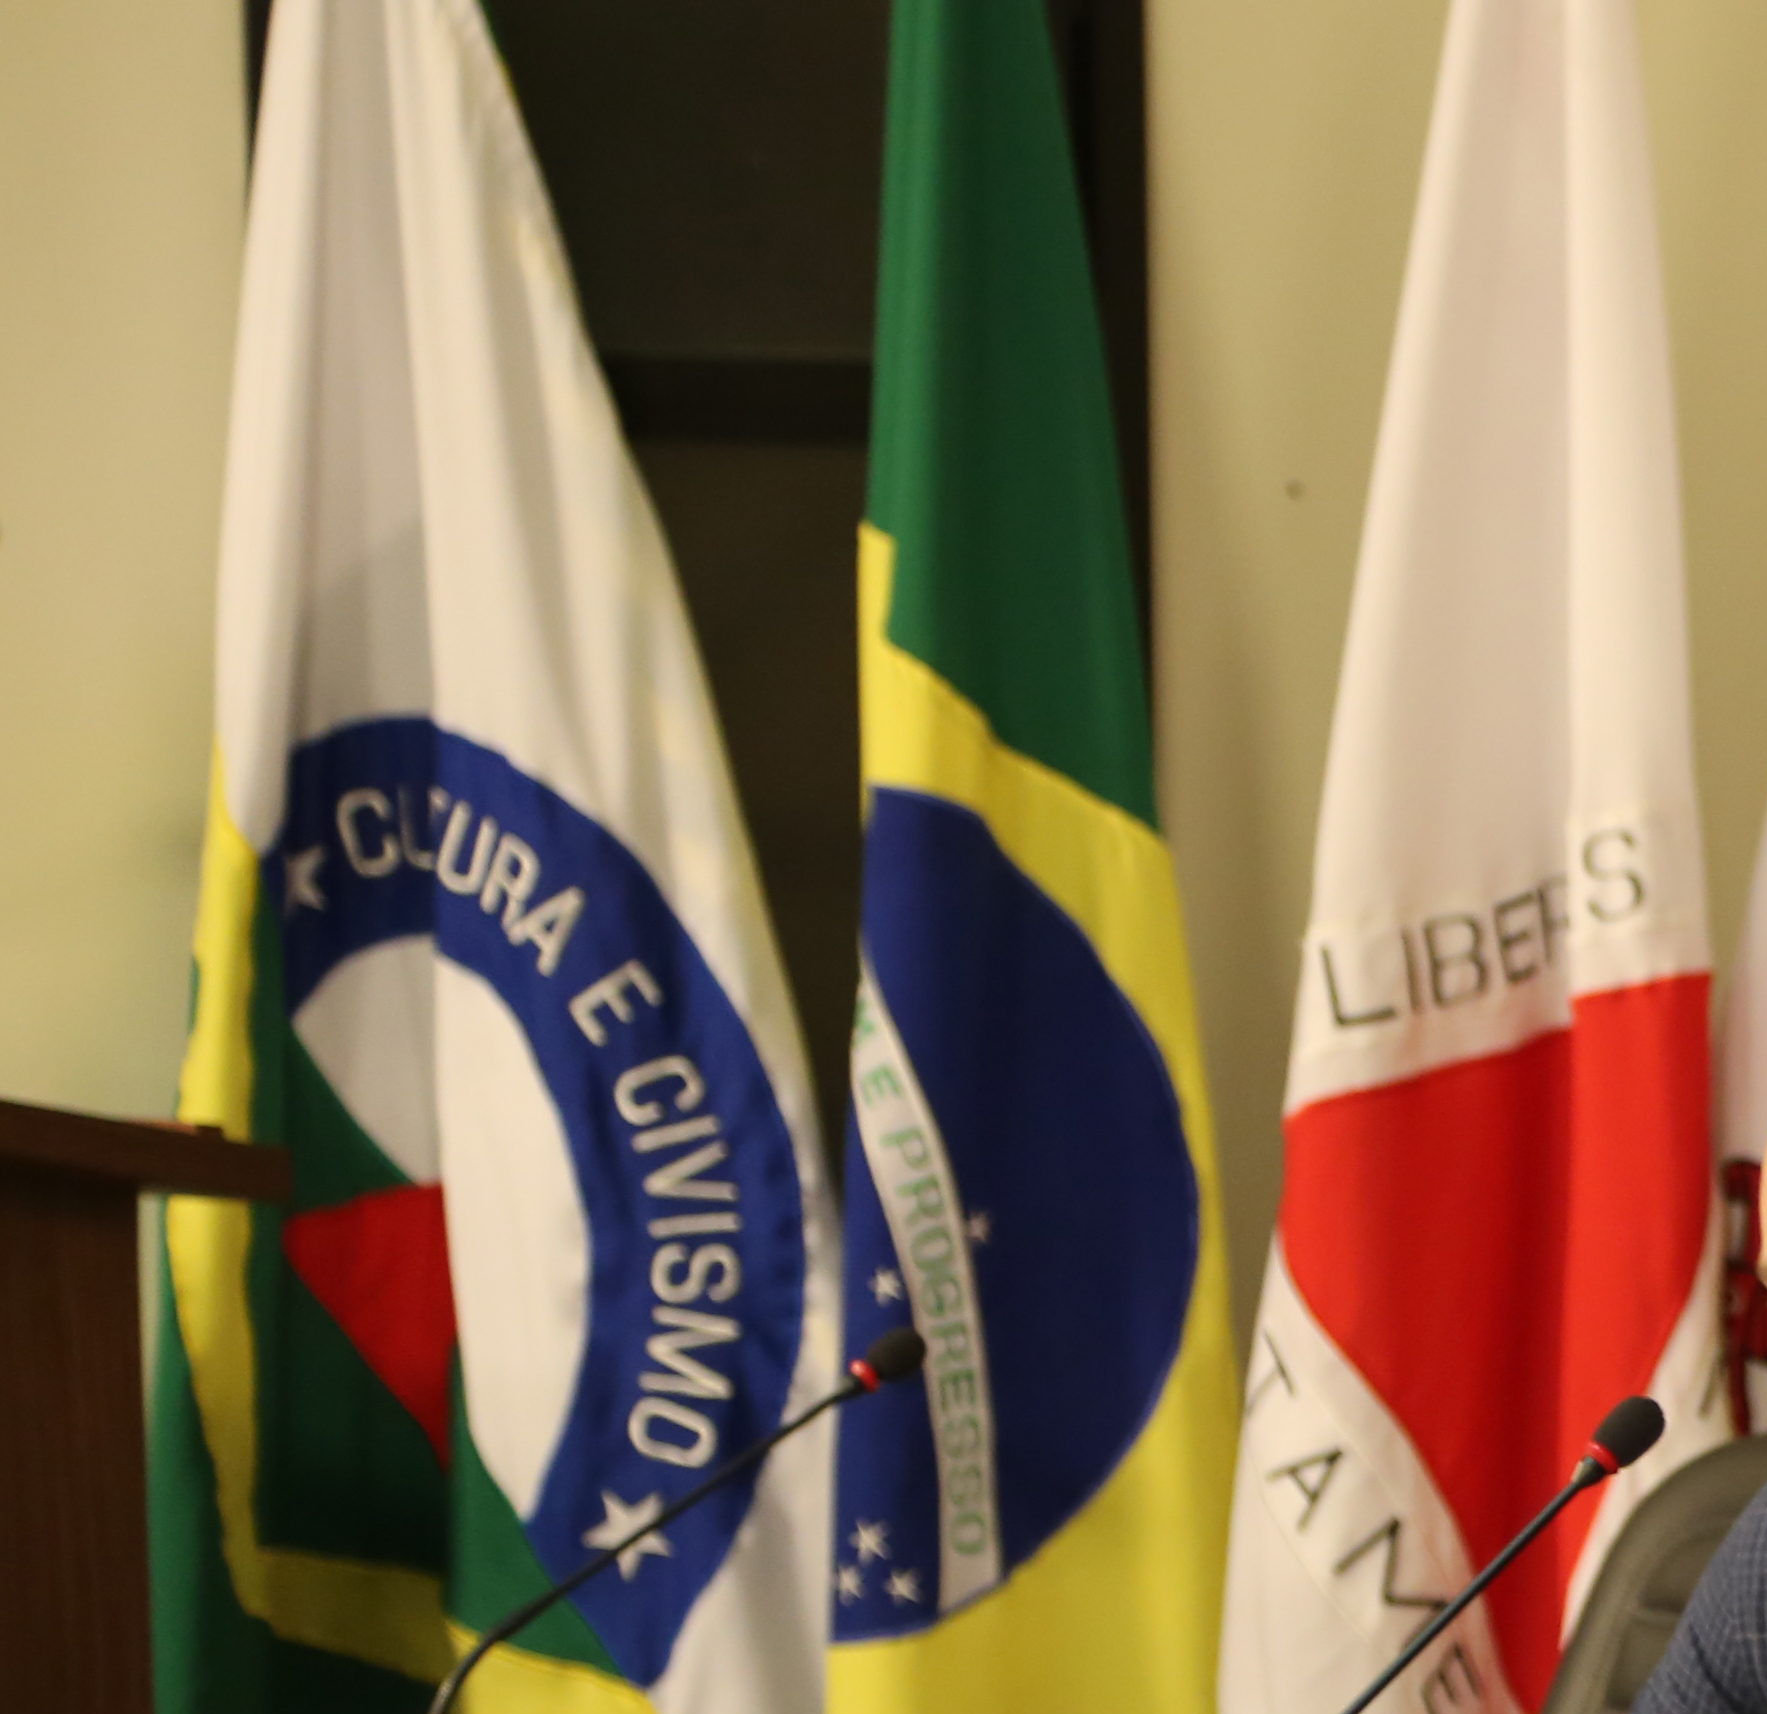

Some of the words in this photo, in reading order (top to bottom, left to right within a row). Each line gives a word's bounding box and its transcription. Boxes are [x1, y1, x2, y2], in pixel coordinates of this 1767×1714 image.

[568, 958, 663, 1046] E
[861, 1063, 903, 1106] E
[614, 1054, 743, 1470] CIVISMO
[879, 1126, 988, 1557] PROGRESSO
